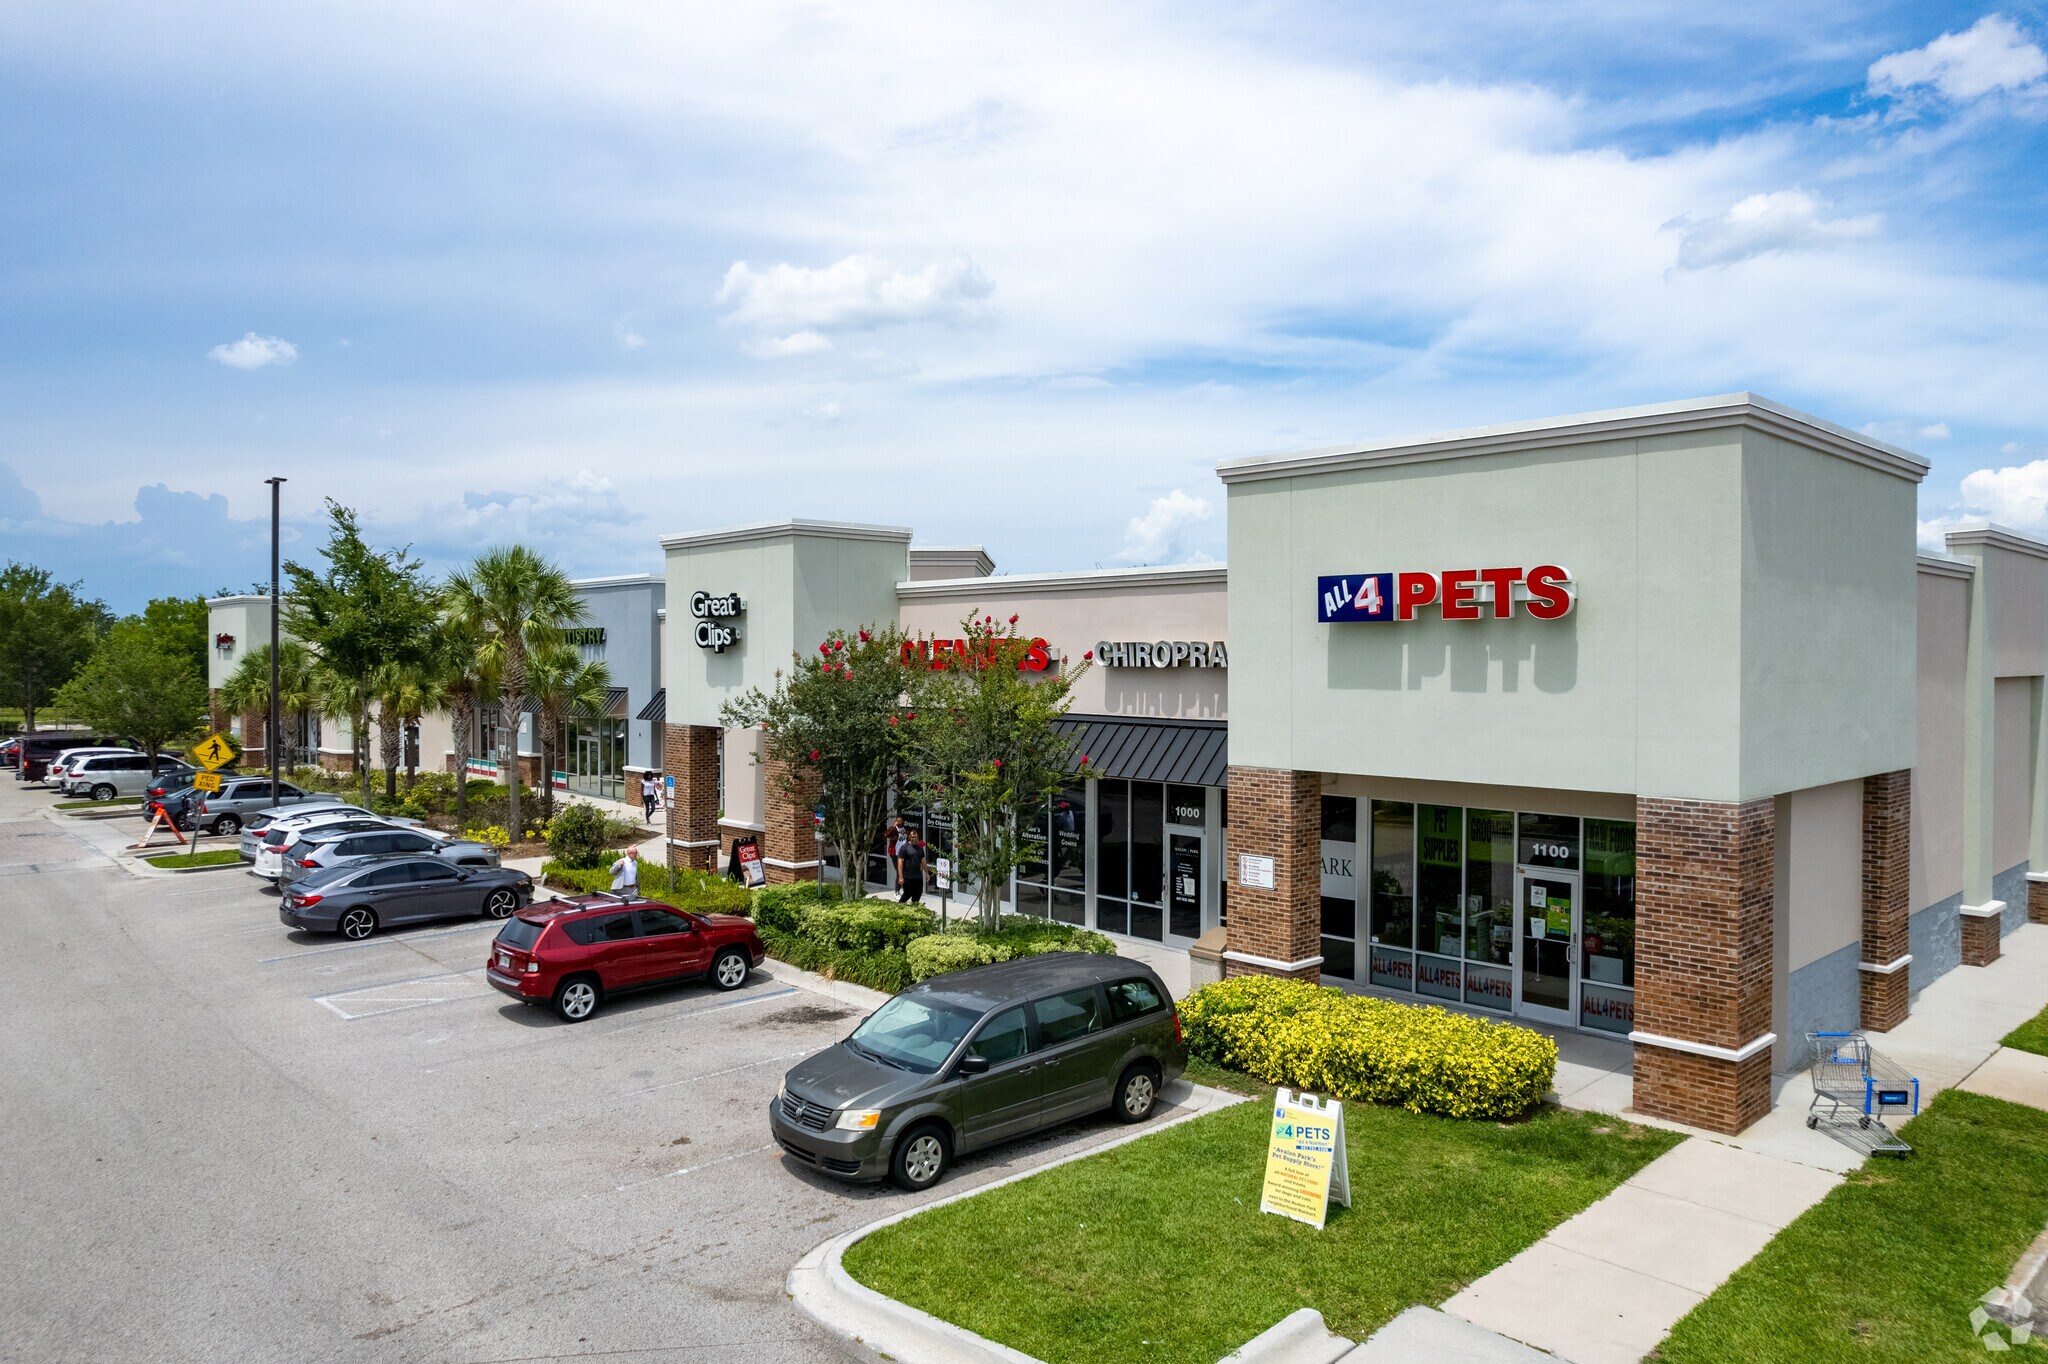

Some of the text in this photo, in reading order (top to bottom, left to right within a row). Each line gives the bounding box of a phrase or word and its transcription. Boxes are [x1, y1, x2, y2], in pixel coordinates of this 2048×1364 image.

[1324, 565, 1573, 620] ALL 4 PETS
[691, 591, 738, 617] Great
[695, 621, 734, 652] Clips
[1175, 806, 1199, 818] 1000
[1434, 808, 1448, 833] PET
[1059, 830, 1080, 840] Wedding
[739, 845, 756, 853] Great
[741, 851, 756, 860] Clips
[1424, 836, 1459, 863] SUPPLIES
[1532, 843, 1569, 859] 1100
[1285, 1124, 1293, 1137] 4
[1296, 1126, 1330, 1140] PETS
[1282, 1155, 1303, 1165] Supply
[1297, 1153, 1316, 1162] Park's
